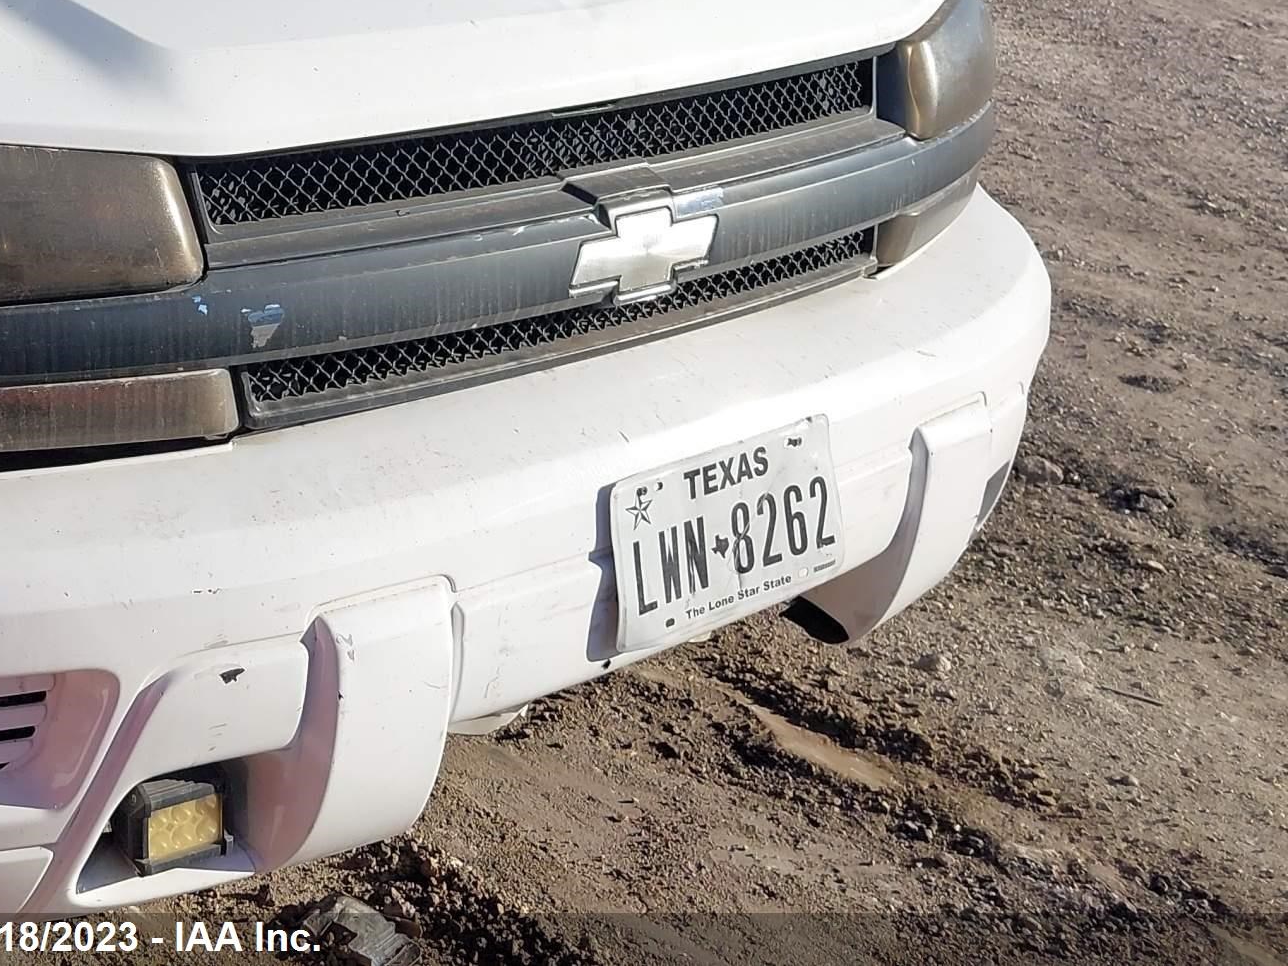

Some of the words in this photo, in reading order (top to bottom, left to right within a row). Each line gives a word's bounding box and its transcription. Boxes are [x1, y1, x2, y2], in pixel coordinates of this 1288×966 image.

[683, 446, 769, 500] TEXAS
[685, 606, 705, 620] The
[708, 596, 735, 611] Lone
[737, 586, 760, 600] Star
[763, 575, 792, 591] State
